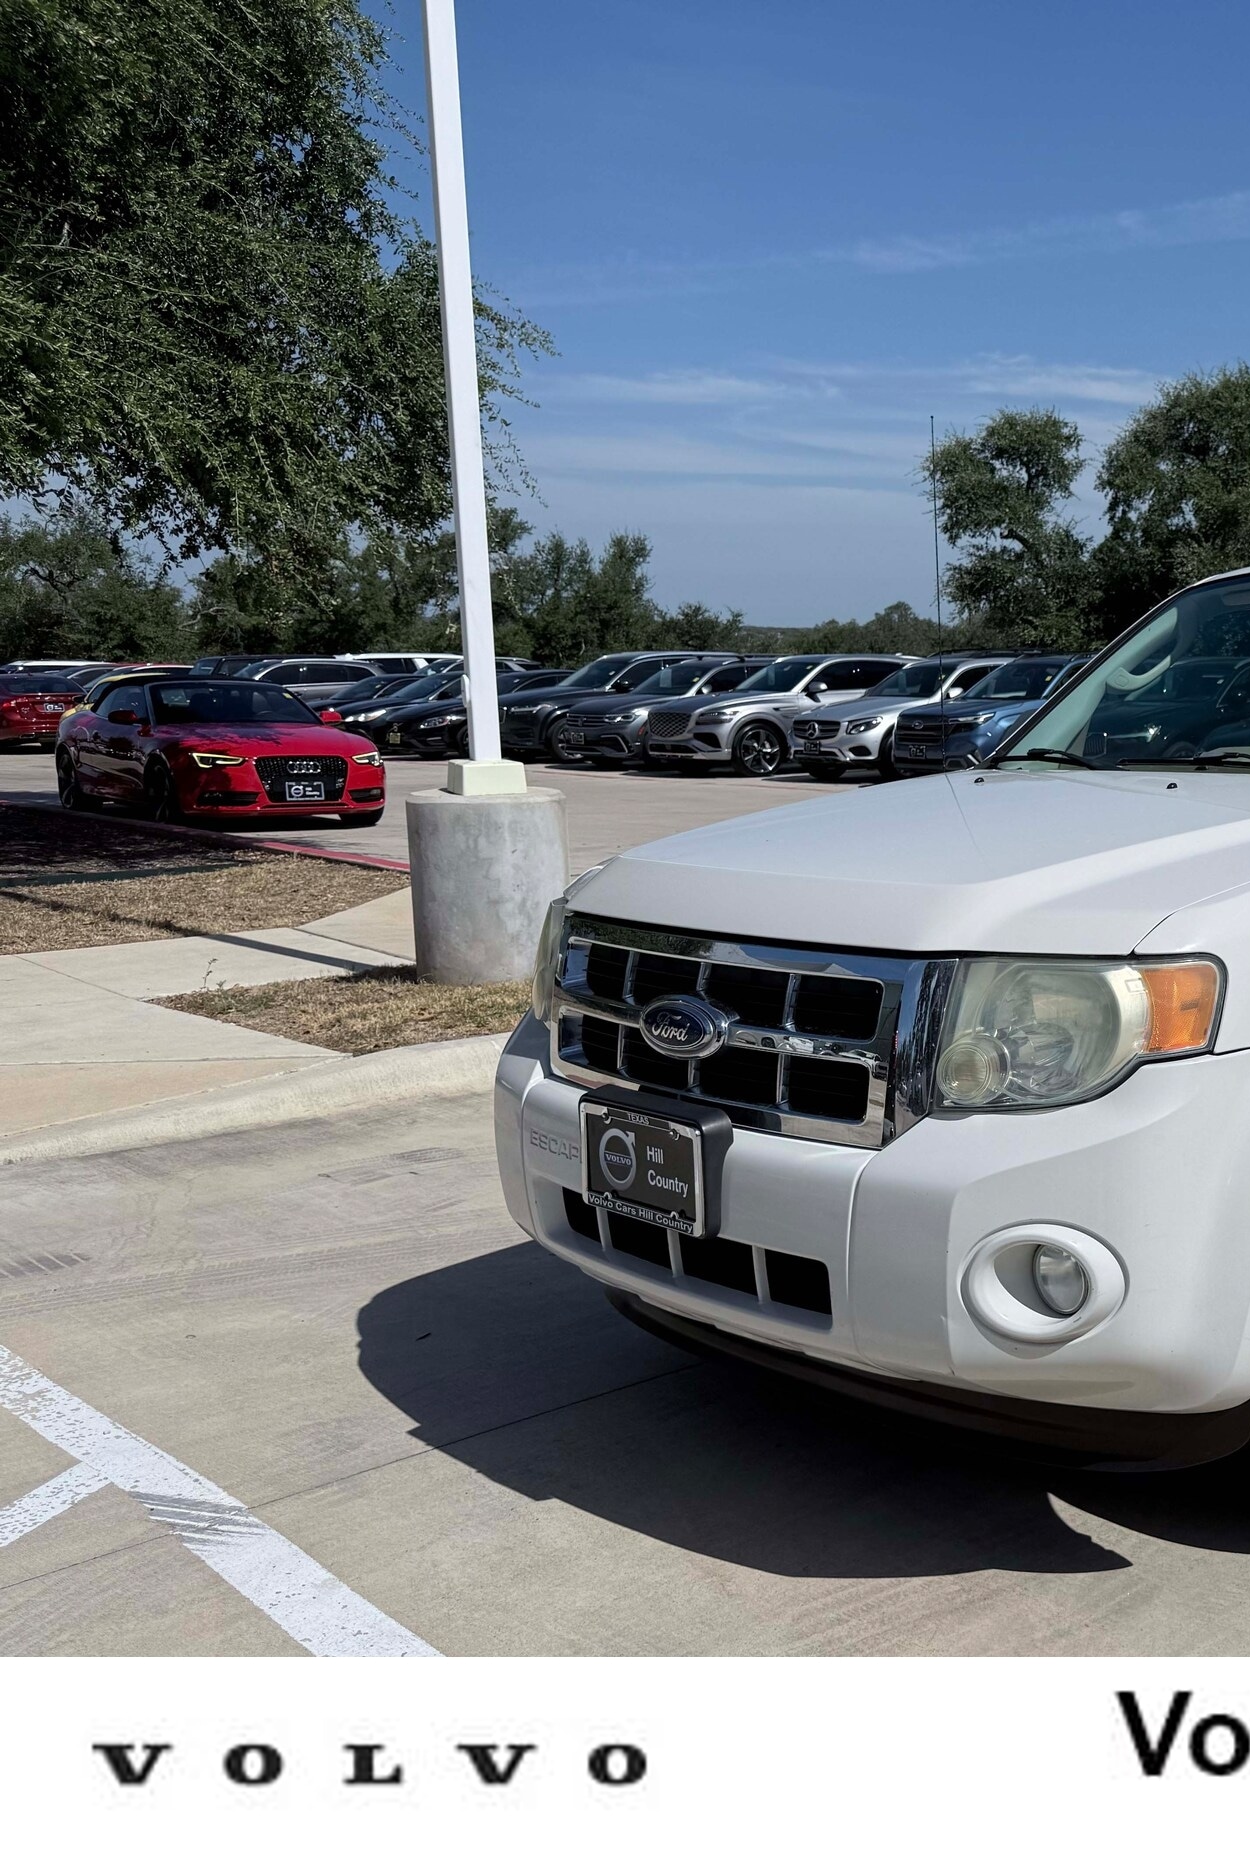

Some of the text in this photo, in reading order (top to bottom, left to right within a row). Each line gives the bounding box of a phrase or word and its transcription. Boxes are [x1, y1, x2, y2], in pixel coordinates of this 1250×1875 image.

[651, 1011, 691, 1041] Ford
[628, 1113, 650, 1125] TEXAS
[530, 1129, 582, 1164] ESCAP
[605, 1153, 632, 1166] VOLVO
[646, 1145, 664, 1164] Hill
[647, 1169, 689, 1198] Country
[588, 1193, 693, 1234] Volvo Cars Hill Country
